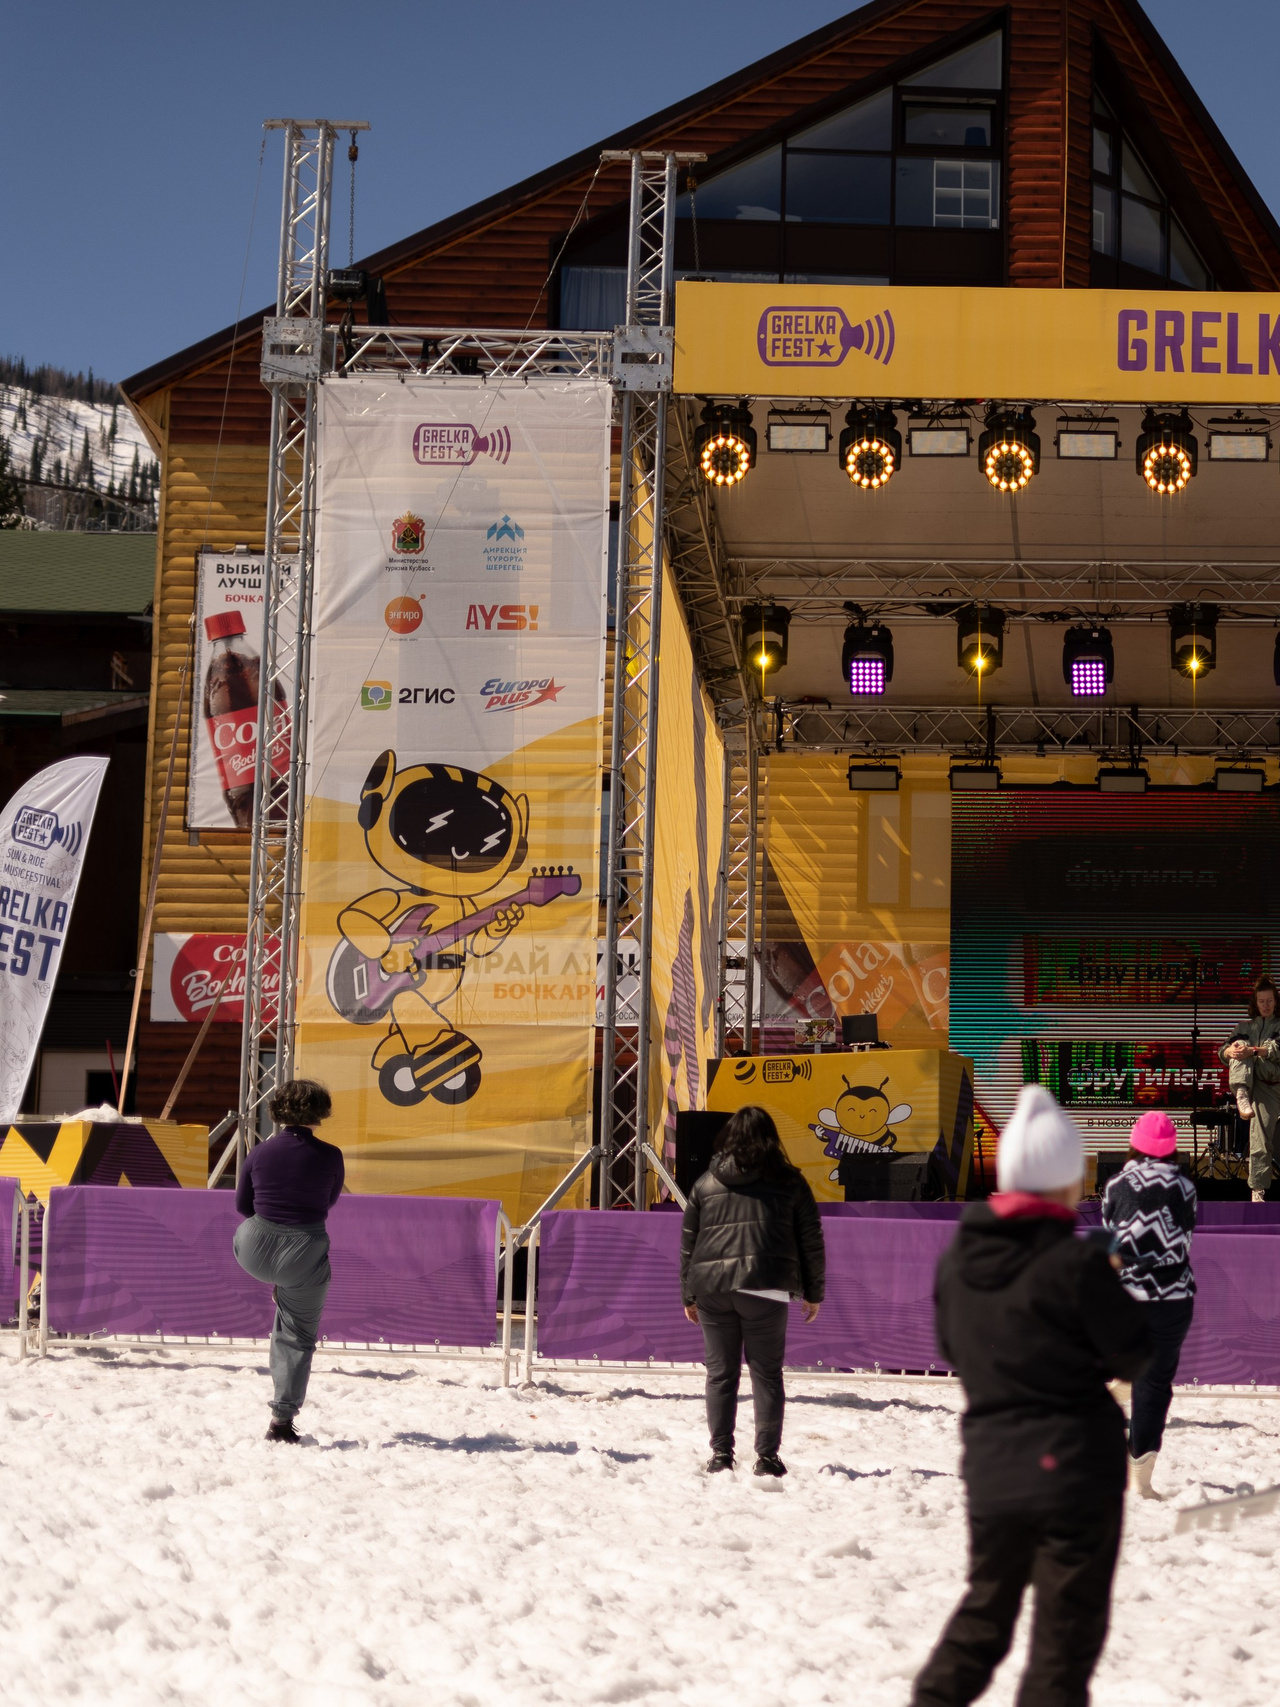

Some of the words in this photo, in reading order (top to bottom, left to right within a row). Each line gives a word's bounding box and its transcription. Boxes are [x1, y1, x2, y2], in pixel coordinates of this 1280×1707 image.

[771, 314, 837, 336] GRELKA
[771, 337, 815, 359] FEST
[422, 429, 470, 444] GRELKA
[422, 445, 454, 460] FEST
[482, 547, 528, 555] ДИРЕКЦИЯ
[389, 557, 429, 565] Министерство
[388, 610, 420, 621] энгиро
[465, 604, 539, 631] AYS!
[398, 687, 456, 705] 2ГИС
[20, 811, 54, 831] GRELKA
[17, 825, 39, 841] FEST
[6, 848, 22, 863] SUN
[27, 856, 45, 869] RIDE
[3, 863, 25, 880] MUSIC
[25, 869, 61, 889] FESTIVAL
[0, 885, 68, 933] RELKA
[0, 922, 62, 982] EST
[767, 1062, 792, 1071] GRELKA
[767, 1071, 785, 1080] FEST
[1125, 1174, 1143, 1192] FILA
